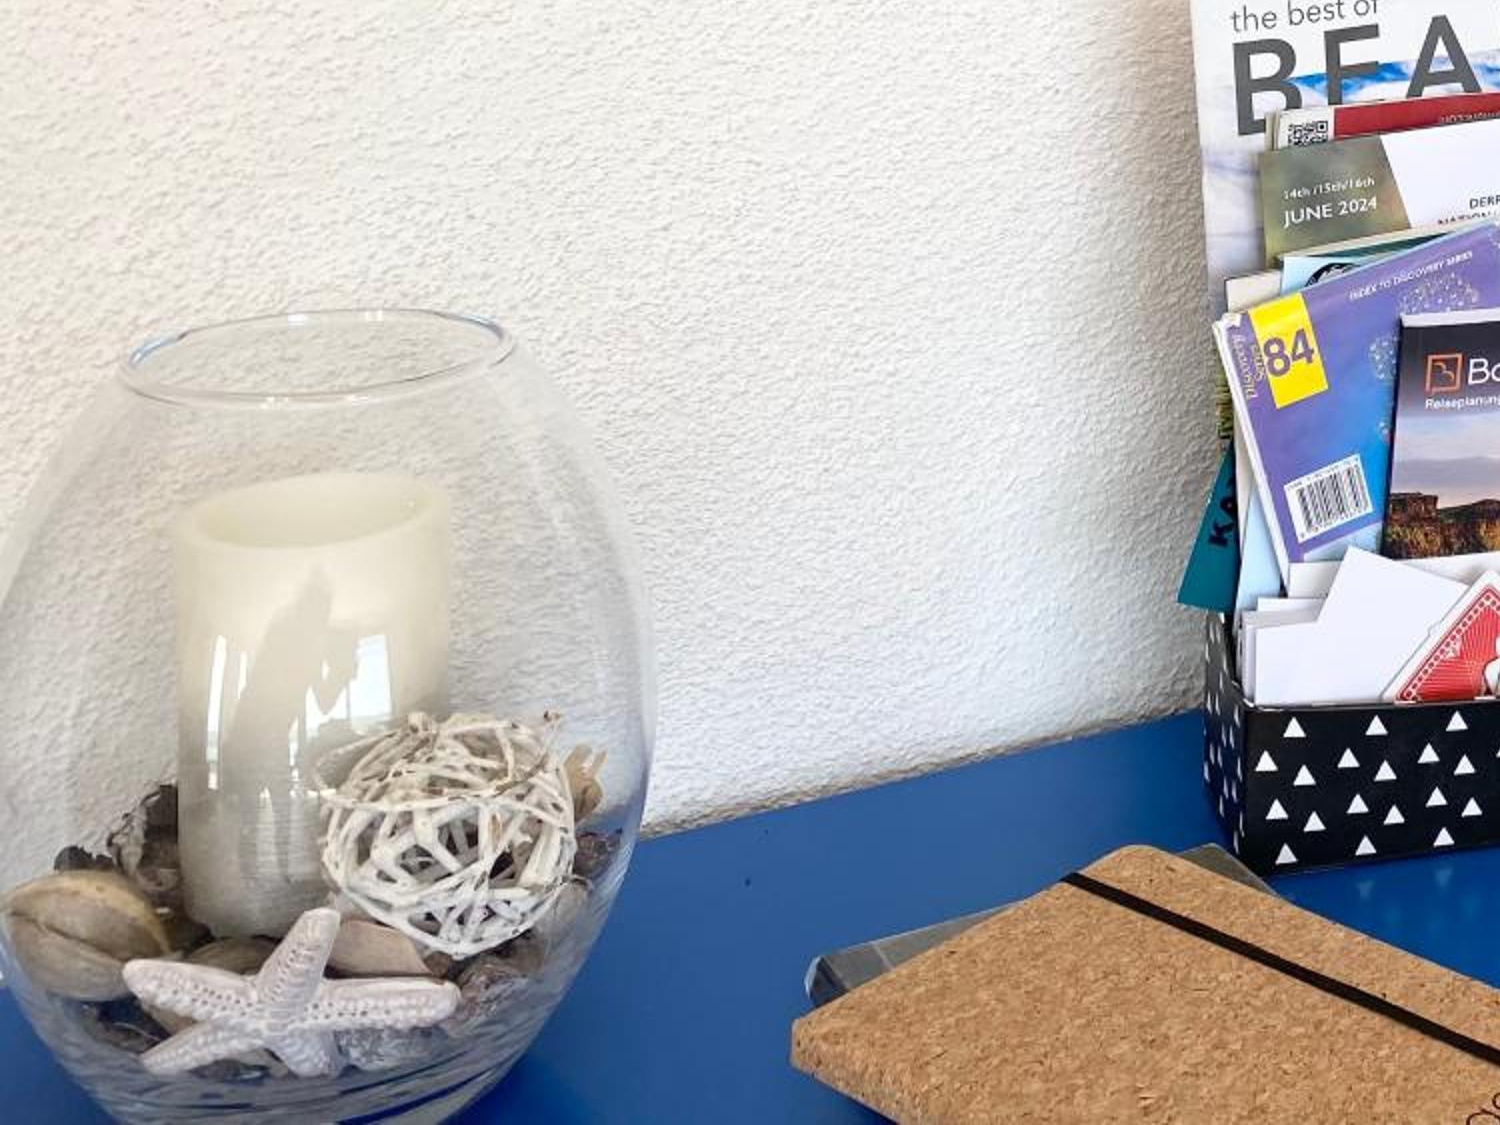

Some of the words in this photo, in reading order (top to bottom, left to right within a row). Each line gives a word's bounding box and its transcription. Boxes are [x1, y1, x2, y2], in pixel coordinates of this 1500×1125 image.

[1230, 4, 1277, 33] the
[1283, 202, 1334, 229] JUNE
[1337, 195, 1378, 216] 2024
[1263, 327, 1315, 377] 84
